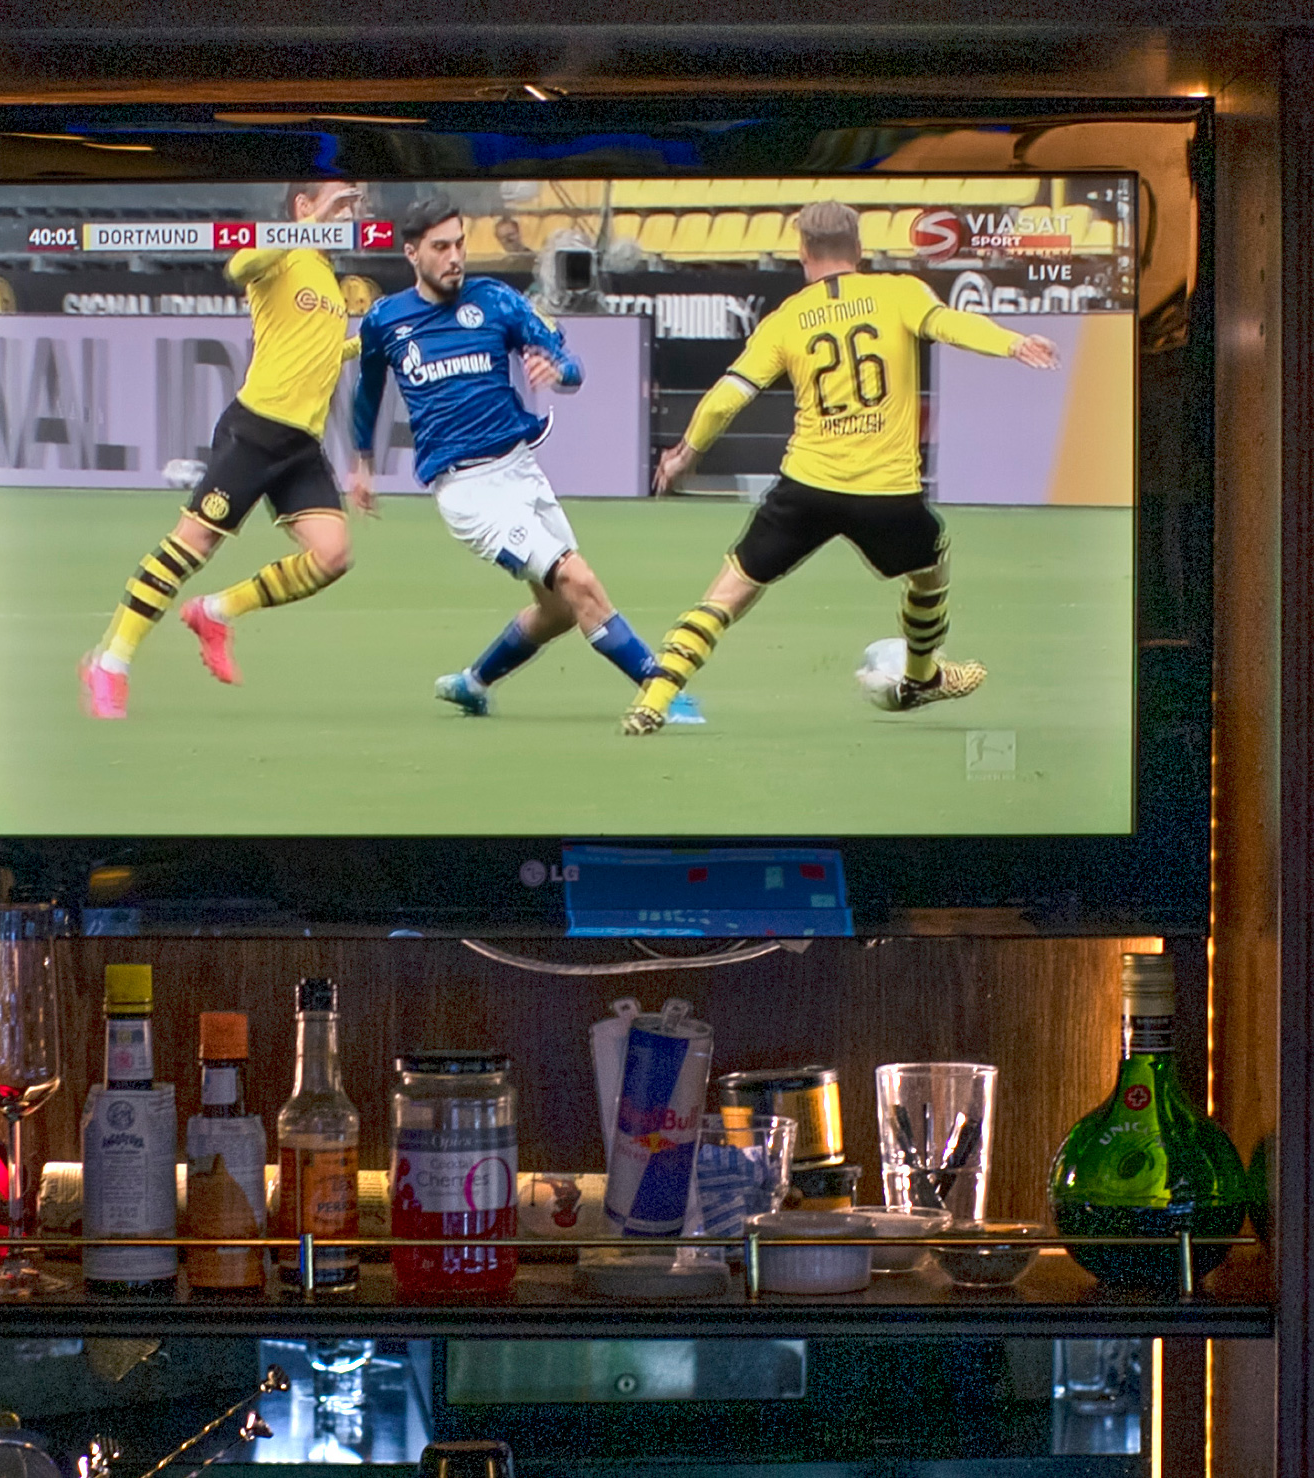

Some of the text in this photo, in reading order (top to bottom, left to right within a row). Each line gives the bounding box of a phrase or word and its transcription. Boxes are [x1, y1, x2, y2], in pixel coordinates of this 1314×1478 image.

[965, 212, 1072, 235] VIASAT
[29, 227, 344, 246] 40:01 DORTMUND 1-0 SCHALKE
[970, 234, 1023, 248] SPORT
[1028, 264, 1072, 281] LIVE
[798, 296, 876, 331] DORTMUND
[425, 351, 492, 384] GAZPROM
[805, 322, 888, 418] 26
[550, 865, 580, 882] LG
[417, 1171, 491, 1188] Cherres
